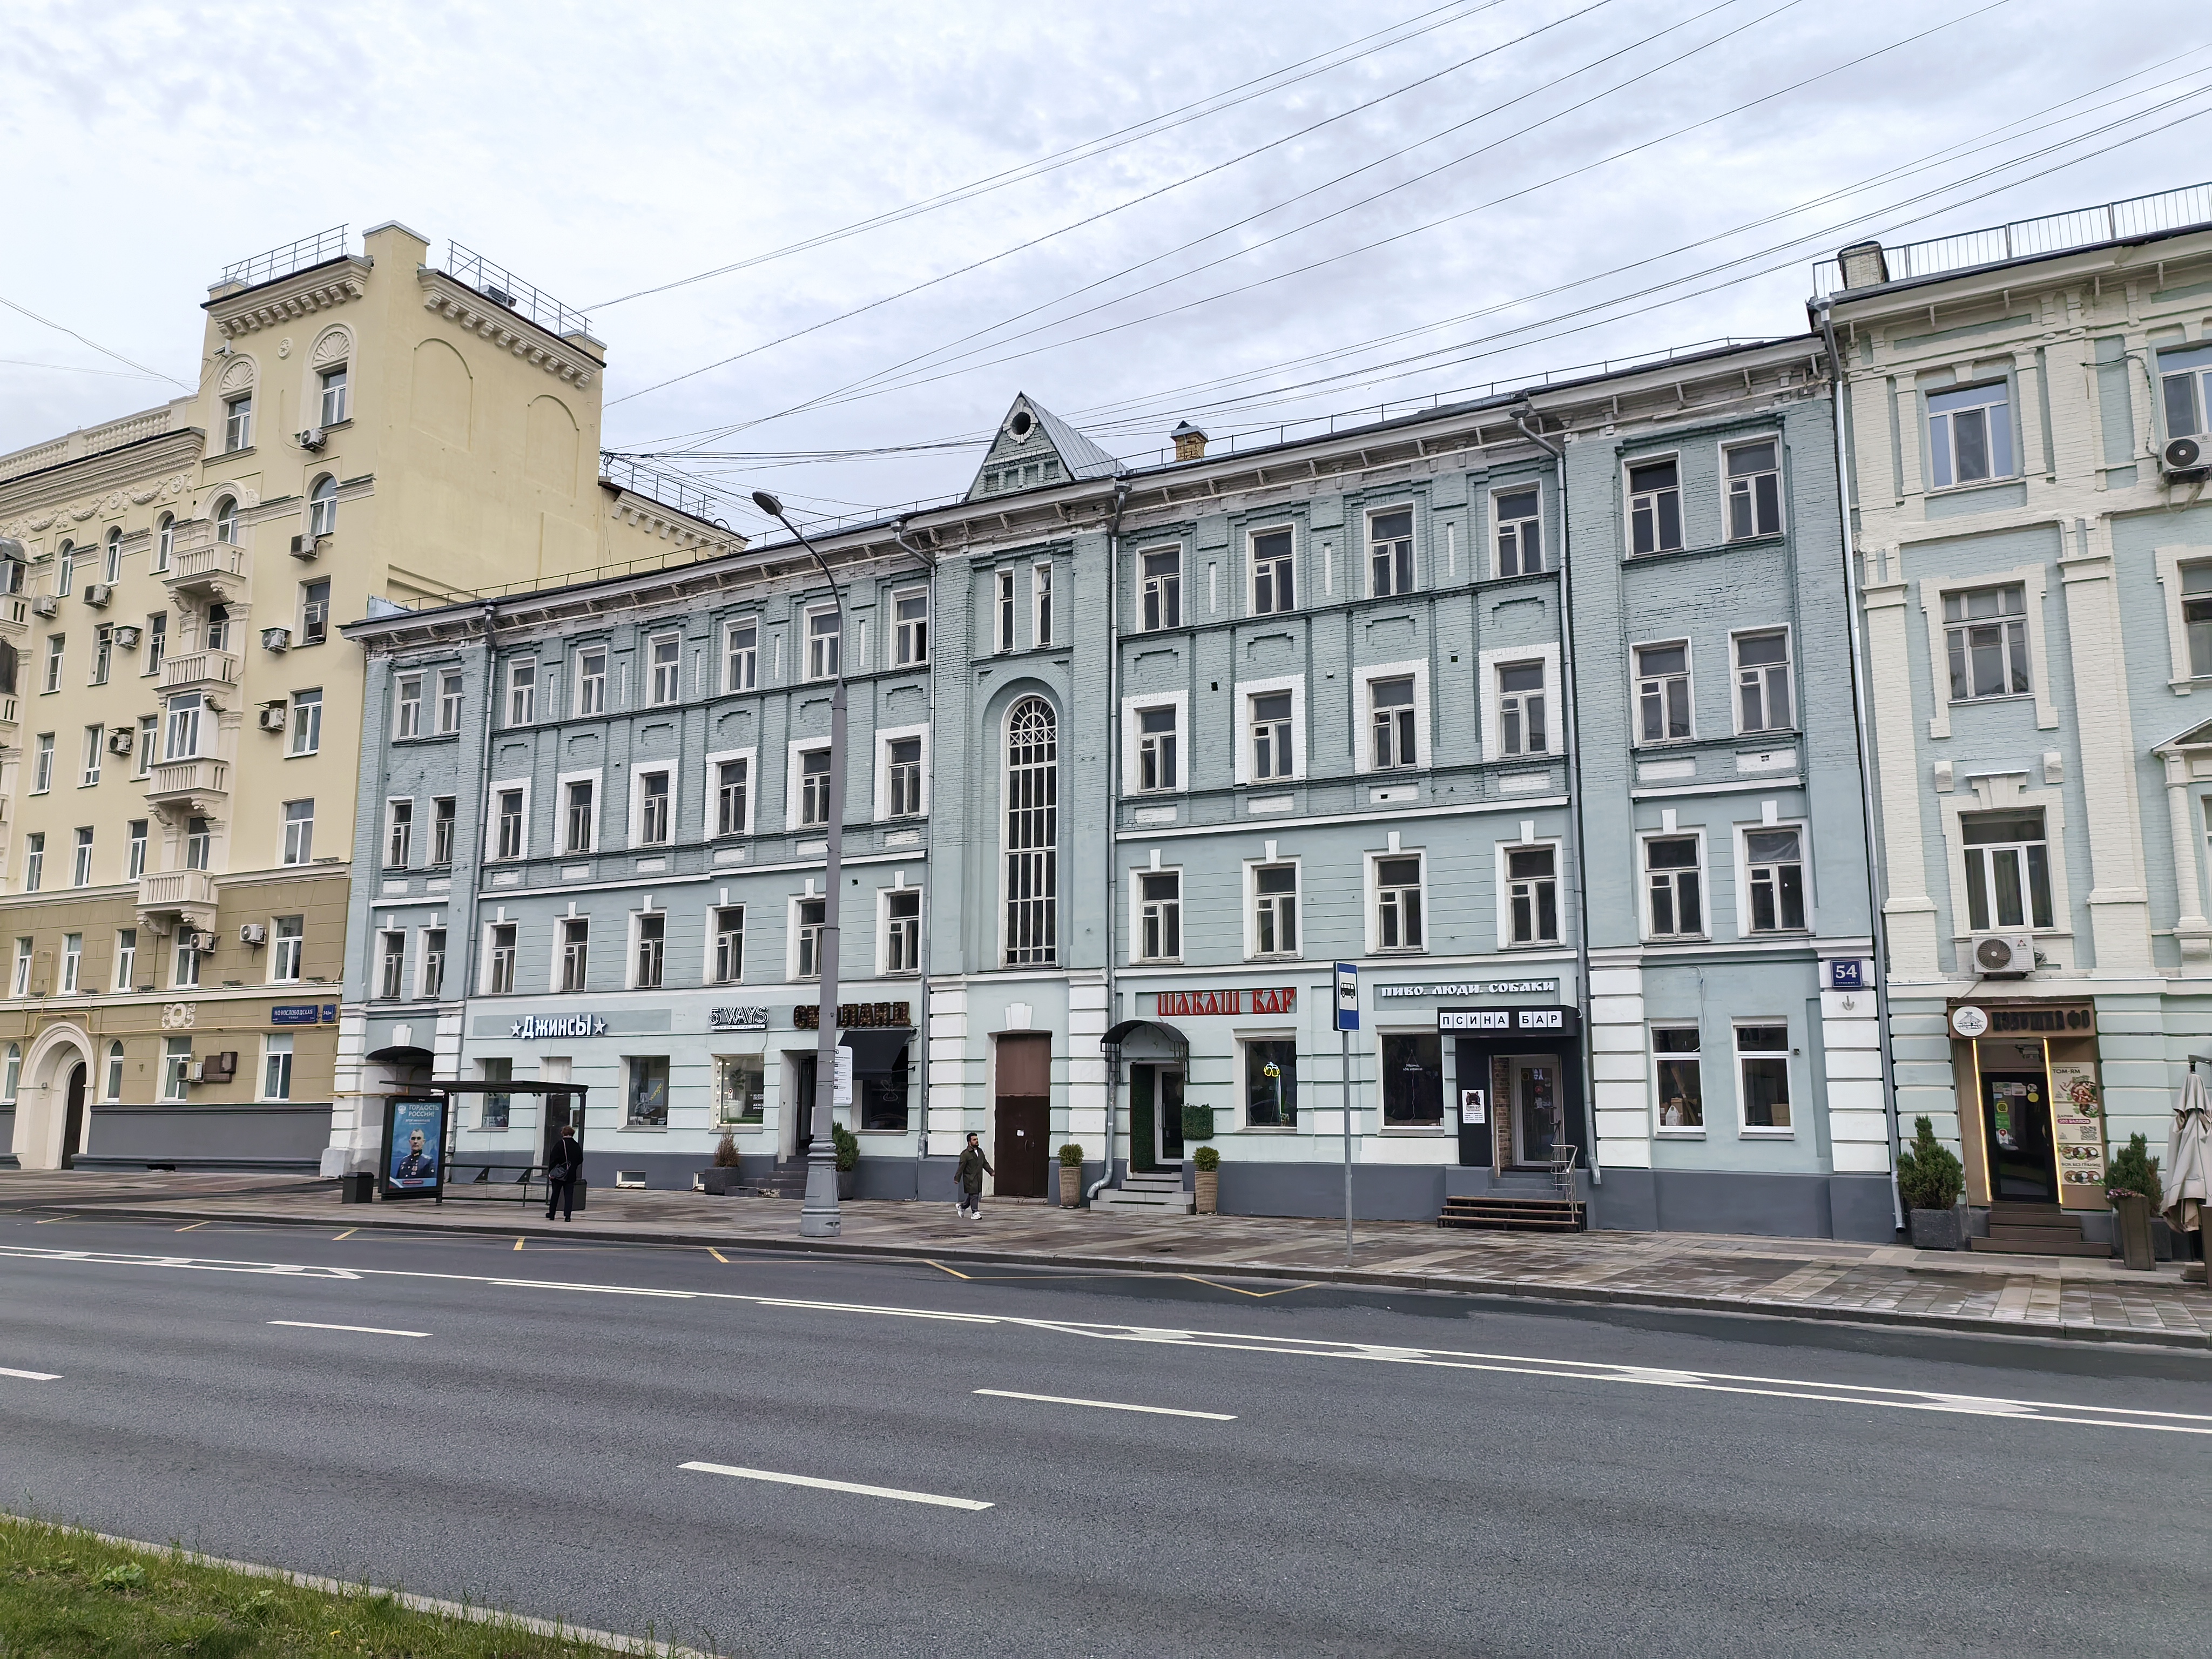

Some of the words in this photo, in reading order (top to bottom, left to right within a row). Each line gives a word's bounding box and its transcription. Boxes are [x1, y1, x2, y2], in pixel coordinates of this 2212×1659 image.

[1836, 965, 1857, 979] 54
[1158, 991, 1241, 1015] ШАБАШ
[1252, 988, 1296, 1014] БАР
[709, 1008, 721, 1025] 5
[724, 1006, 769, 1024] WAYS
[794, 1002, 911, 1028] СМЛАНД
[1522, 1015, 1557, 1023] БАР
